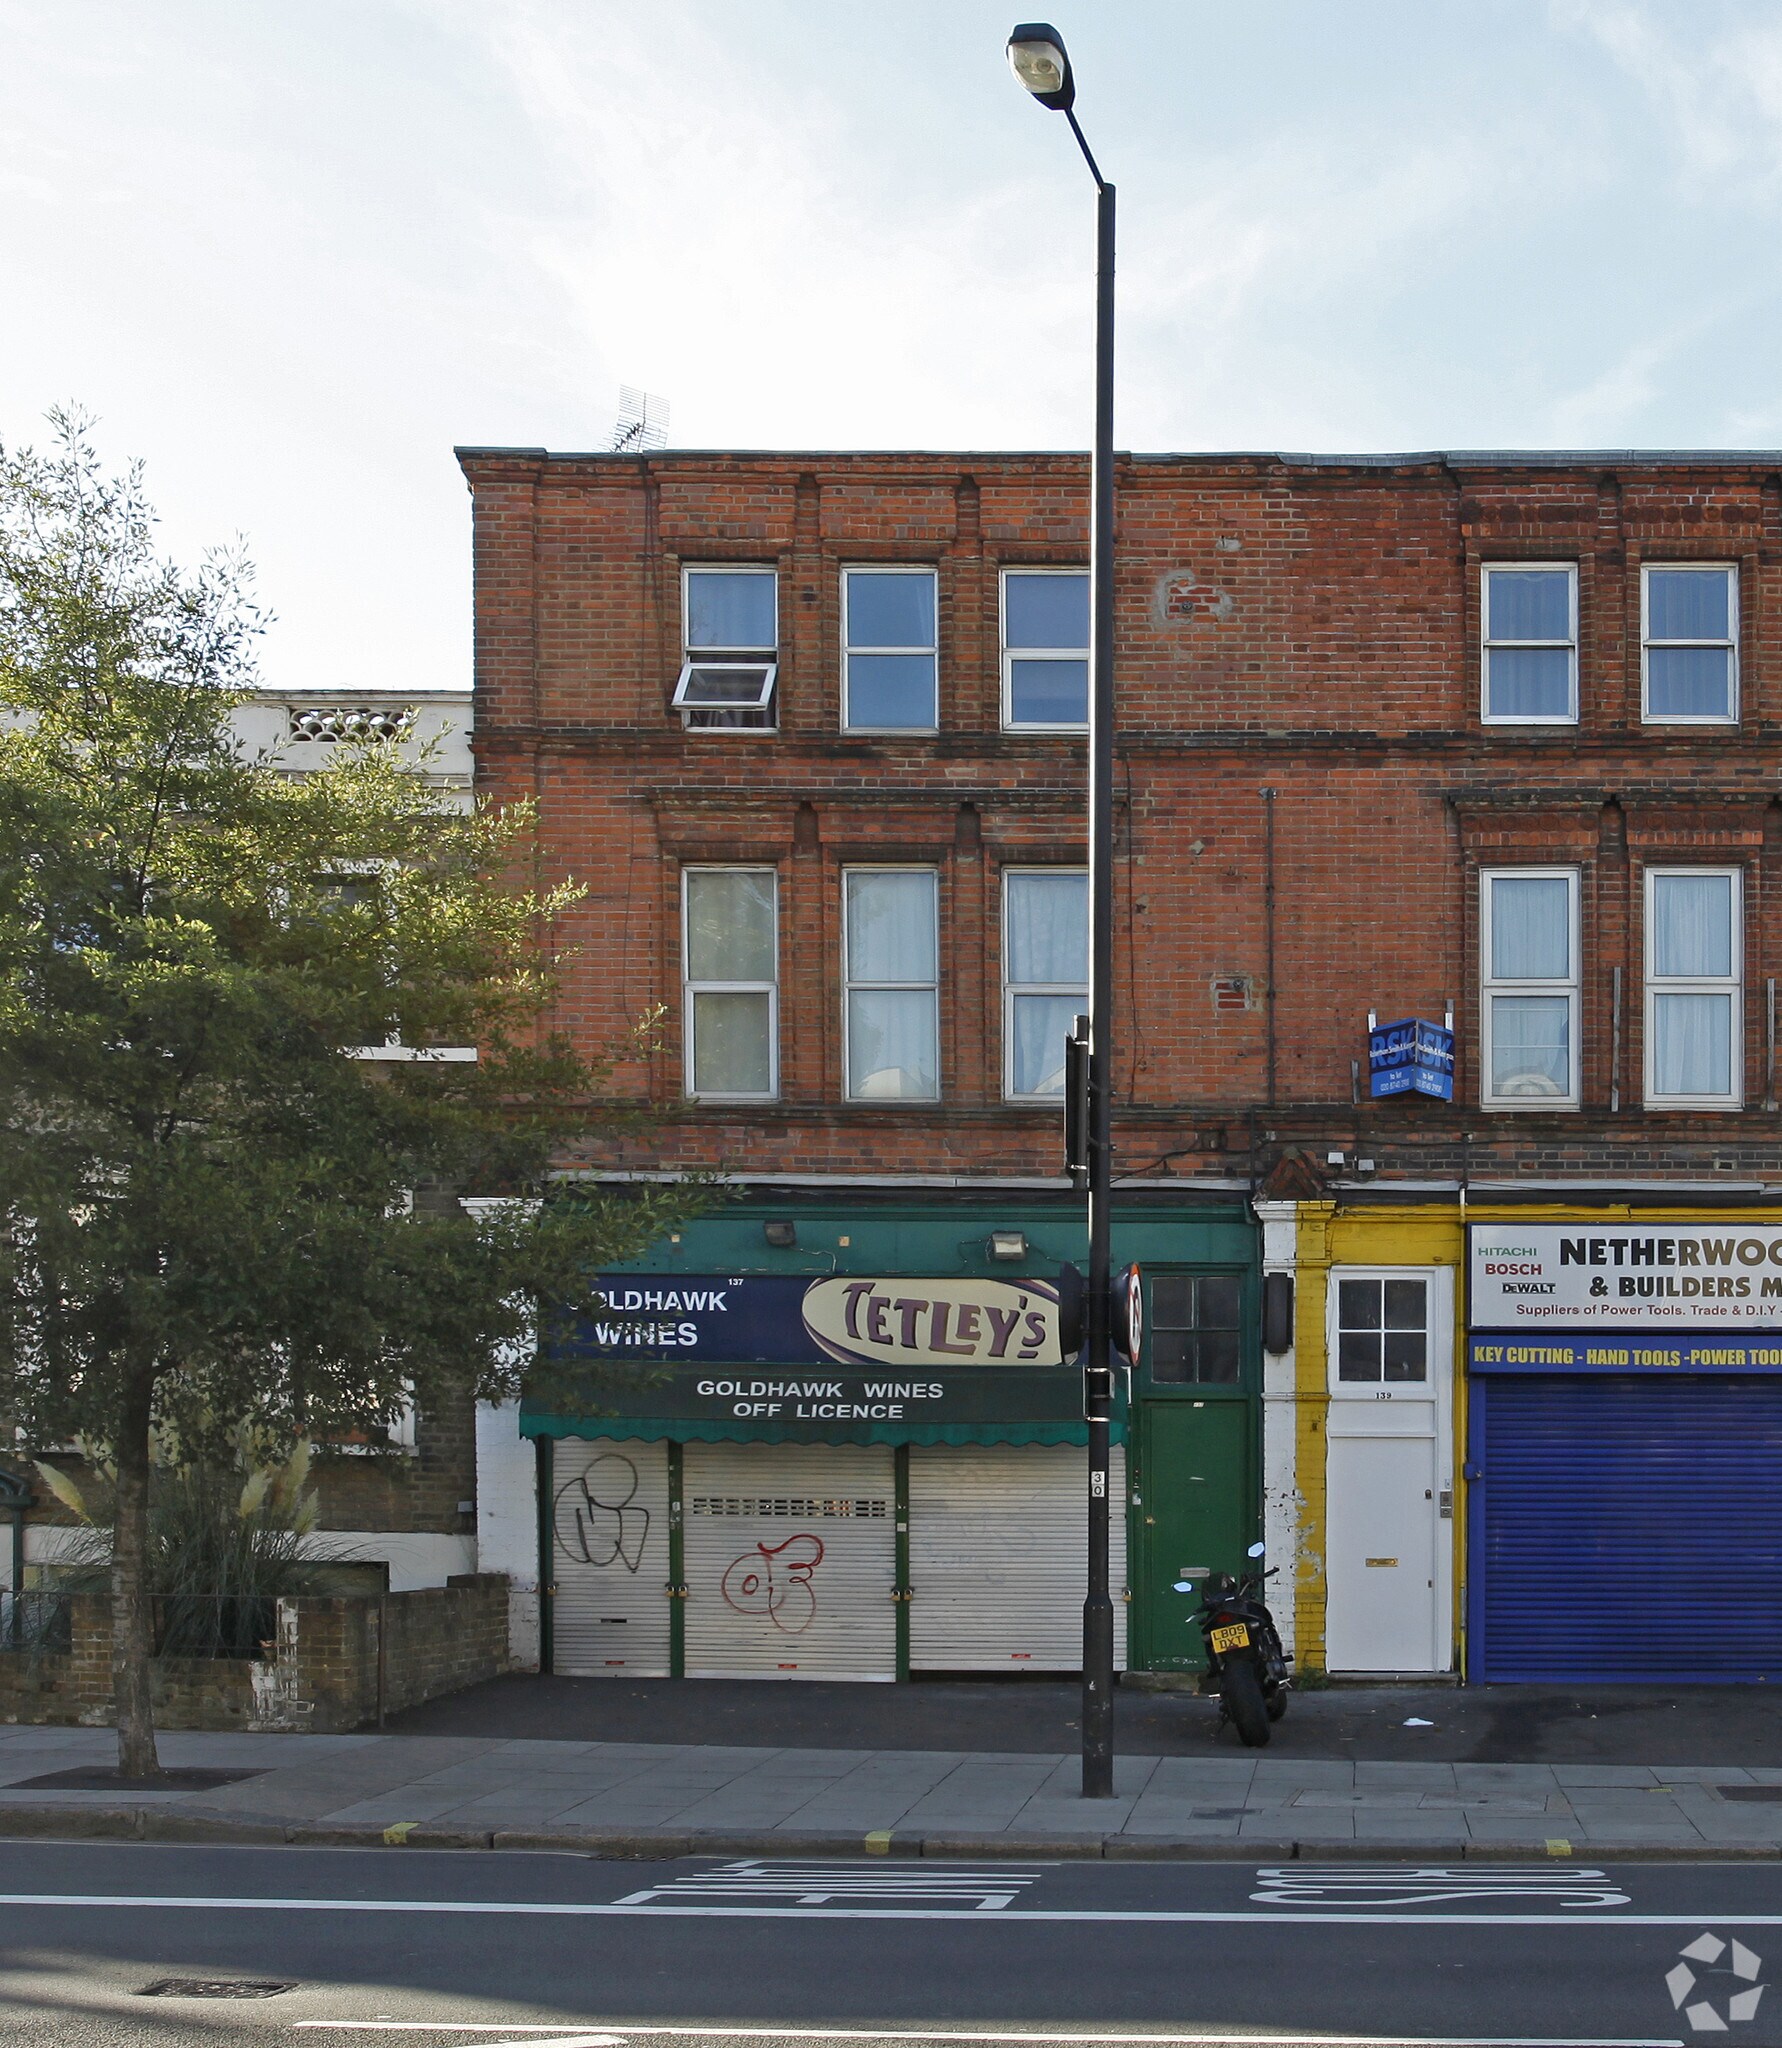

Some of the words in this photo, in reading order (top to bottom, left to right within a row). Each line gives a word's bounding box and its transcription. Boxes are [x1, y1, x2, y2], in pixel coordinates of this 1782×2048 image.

[1371, 1027, 1415, 1068] RSK
[1478, 1247, 1537, 1256] HITACHI
[1485, 1263, 1542, 1275] BOSCH
[728, 1278, 744, 1287] 137
[1589, 1276, 1608, 1297] &
[1619, 1277, 1751, 1297] BUILDERS
[1516, 1304, 1579, 1317] Suppliers
[1584, 1304, 1597, 1315] of
[1601, 1305, 1642, 1315] Power
[1647, 1304, 1686, 1315] Tools.
[1690, 1305, 1727, 1315] Trade
[1732, 1305, 1741, 1315] &
[1746, 1305, 1776, 1315] D.I.Y
[842, 1282, 1046, 1358] TETLEY'S
[595, 1322, 698, 1346] WINES
[1474, 1346, 1504, 1362] KEY
[1506, 1347, 1573, 1364] CUTTING
[1586, 1349, 1629, 1365] HAND
[1632, 1350, 1681, 1366] TOOLS
[1749, 1349, 1782, 1365] TOO
[696, 1381, 843, 1397] GOLDHAWK
[863, 1383, 944, 1398] WINES
[733, 1403, 782, 1417] OFF
[796, 1404, 903, 1419] LICENCE
[1213, 1625, 1245, 1640] LB09
[1220, 1635, 1243, 1649] DXT
[611, 1860, 1060, 1909] LANE
[1248, 1868, 1633, 1907] BUS
